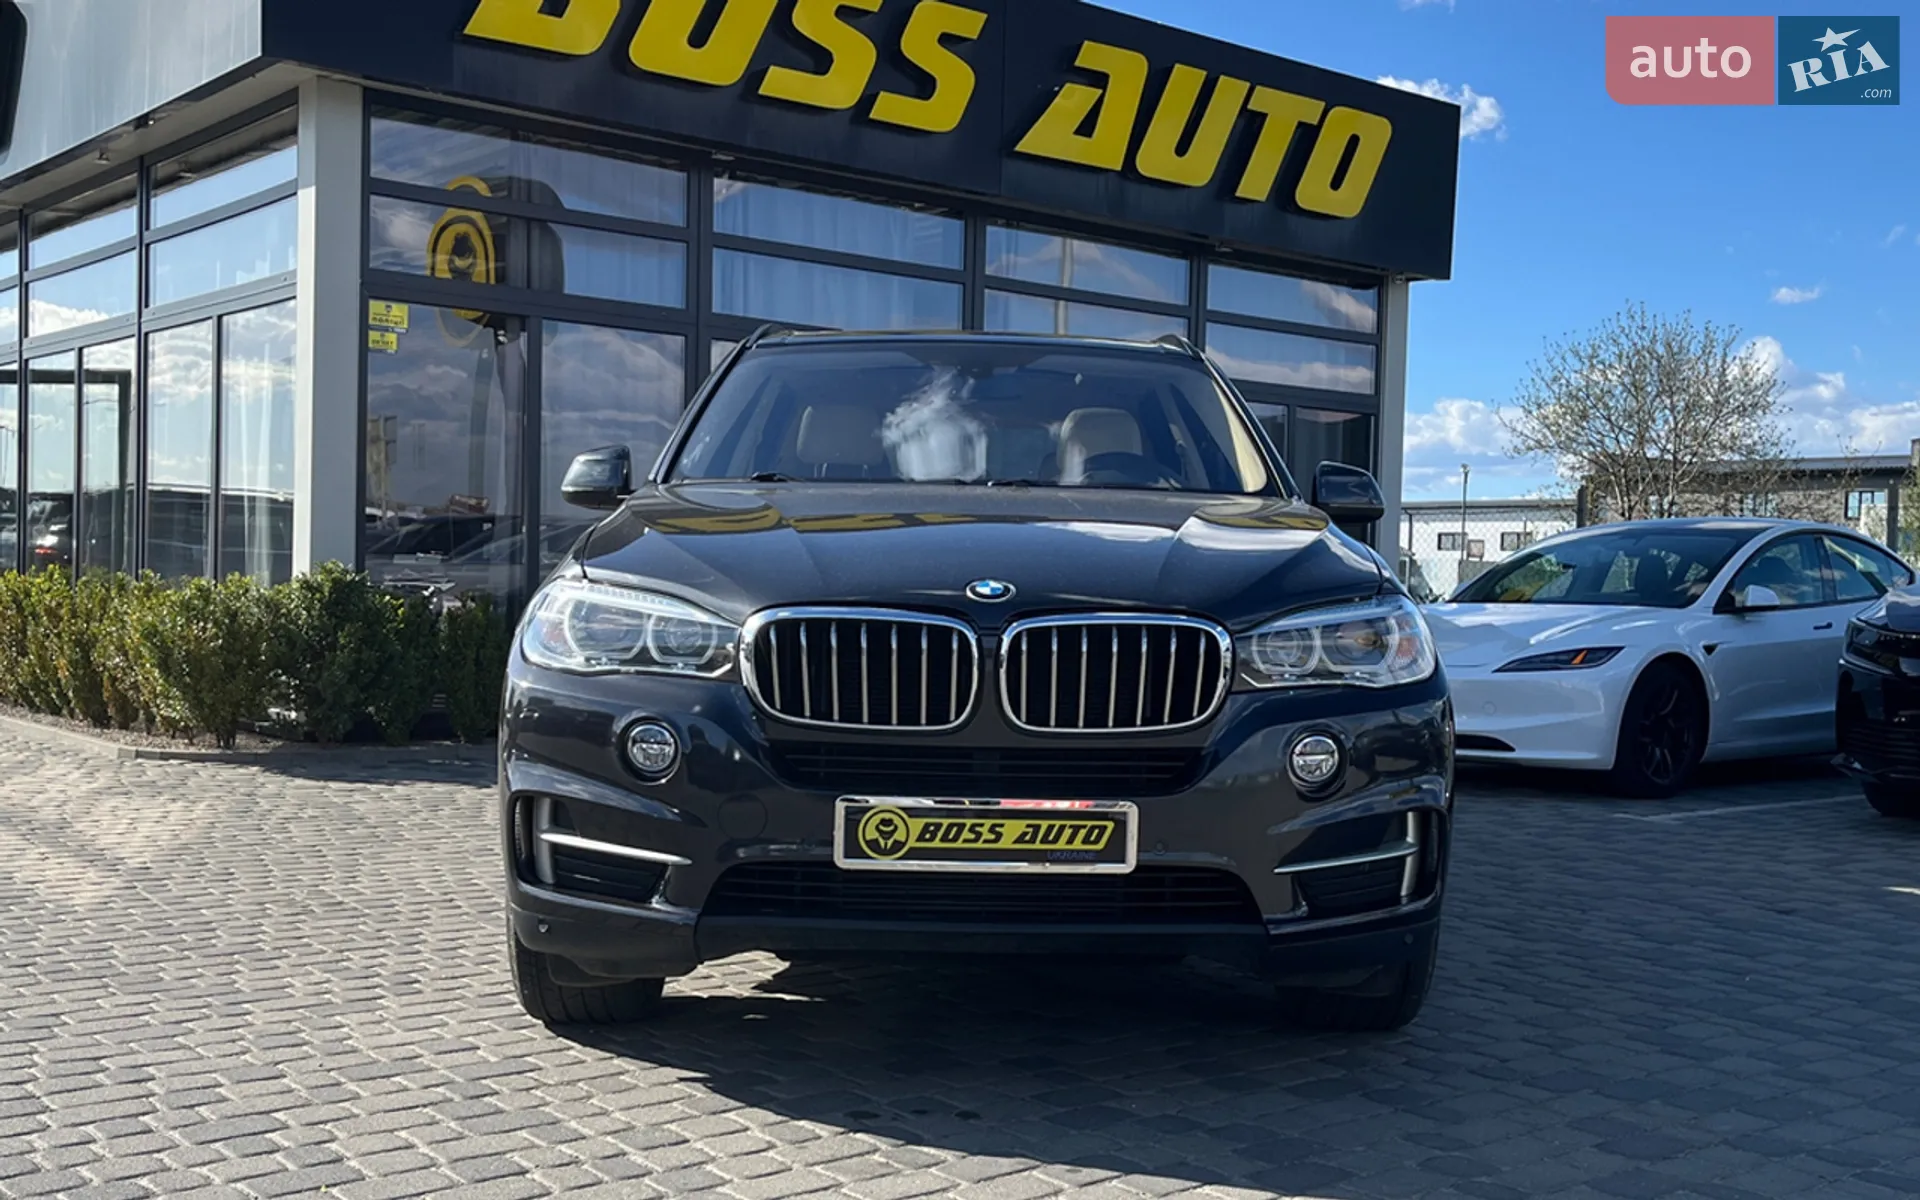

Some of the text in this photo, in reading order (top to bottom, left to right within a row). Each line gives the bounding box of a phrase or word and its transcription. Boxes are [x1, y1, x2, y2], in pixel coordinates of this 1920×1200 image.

[1013, 39, 1393, 219] AUTO
[914, 821, 1109, 846] BOSS AUTO
